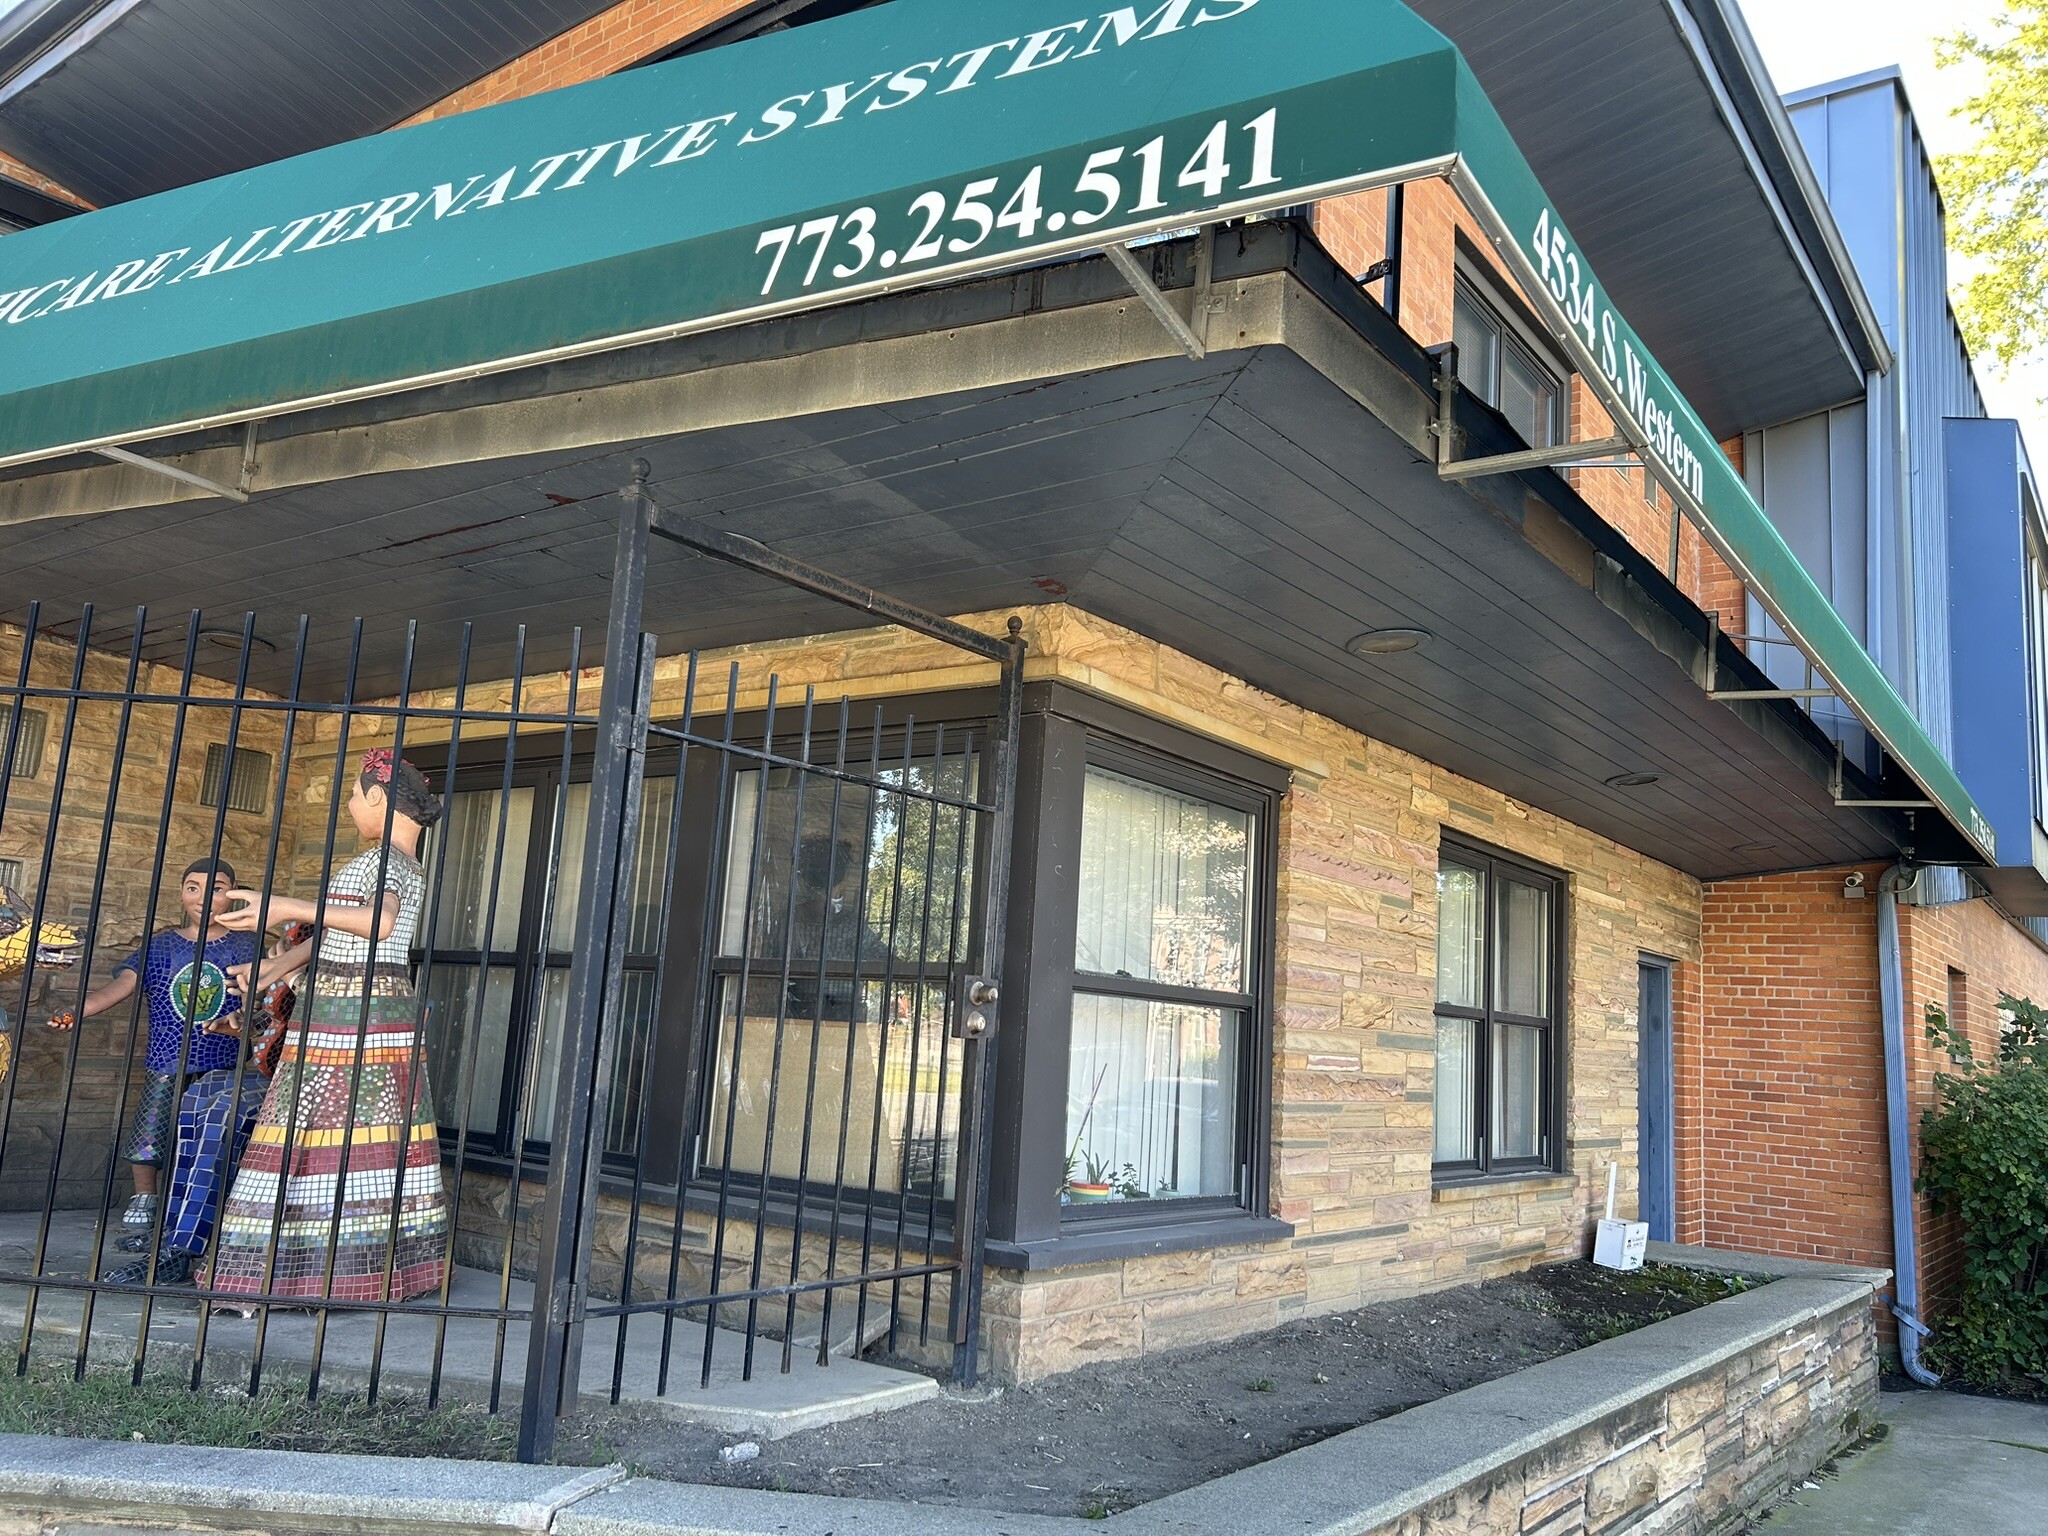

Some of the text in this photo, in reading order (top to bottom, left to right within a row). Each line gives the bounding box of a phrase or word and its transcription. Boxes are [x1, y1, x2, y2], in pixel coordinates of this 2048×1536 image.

[165, 112, 738, 285] ALTERNATIVE
[754, 107, 1283, 296] 773.254.5141
[1532, 207, 1596, 351] 4534
